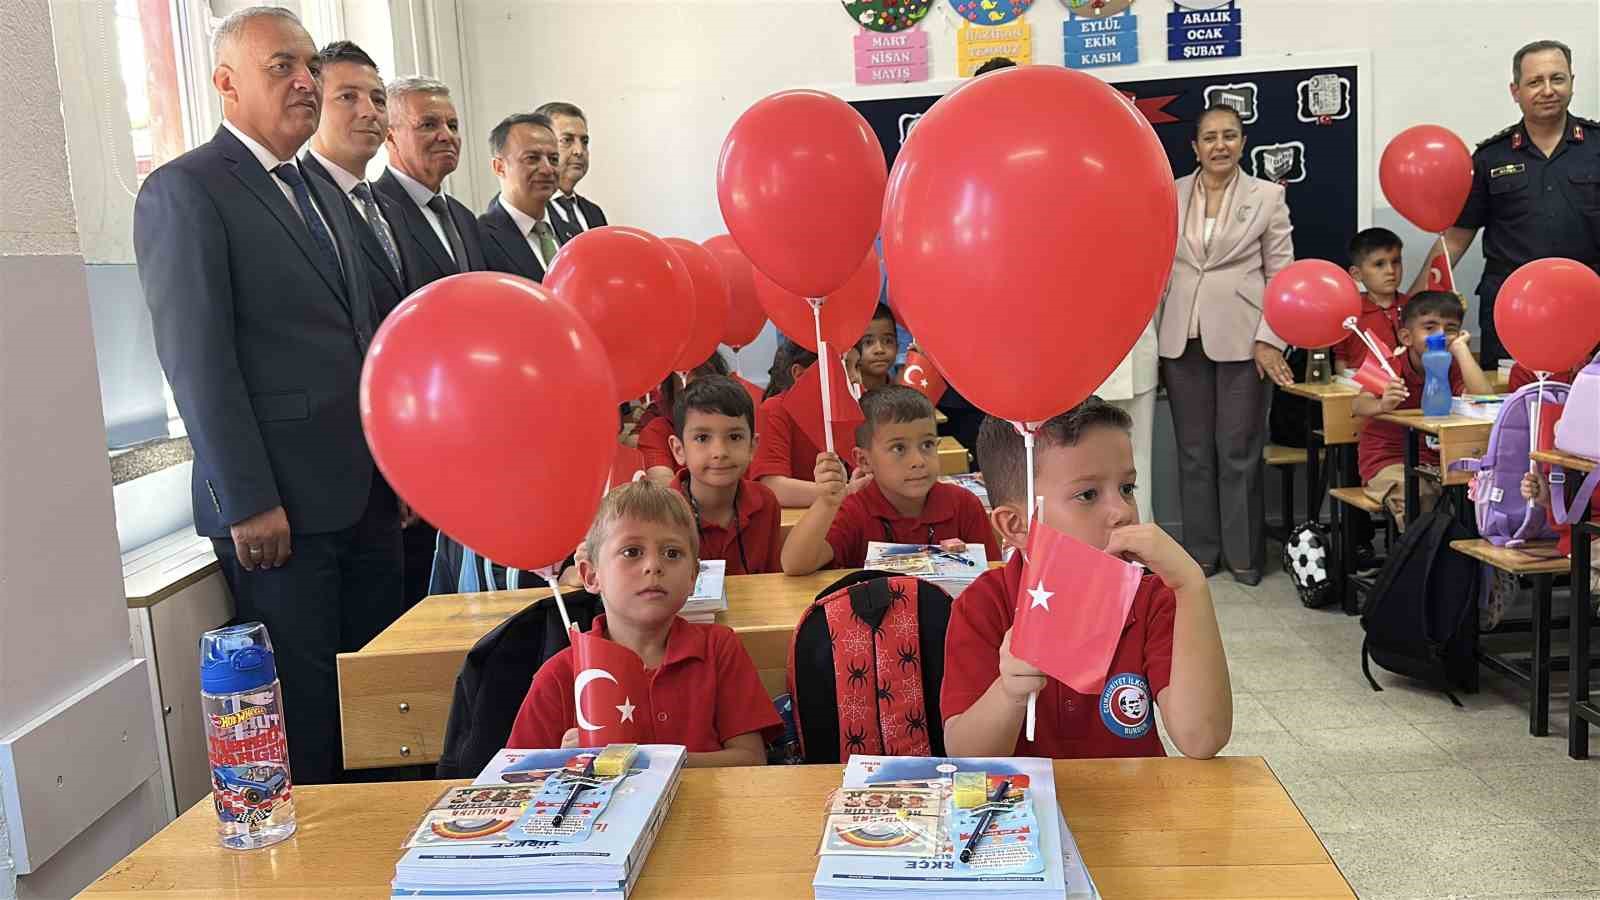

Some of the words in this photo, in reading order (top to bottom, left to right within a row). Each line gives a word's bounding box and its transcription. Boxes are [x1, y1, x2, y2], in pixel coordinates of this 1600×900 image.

[1183, 11, 1231, 25] ARALIK
[1081, 17, 1121, 33] EYLÜL
[1084, 33, 1117, 48] EKİM
[1187, 28, 1223, 40] OCAK
[872, 35, 908, 48] MART
[871, 51, 911, 65] NİSAN
[1183, 45, 1225, 58] ŞUBAT
[1081, 52, 1121, 65] KASIM
[904, 861, 955, 870] RKÇE
